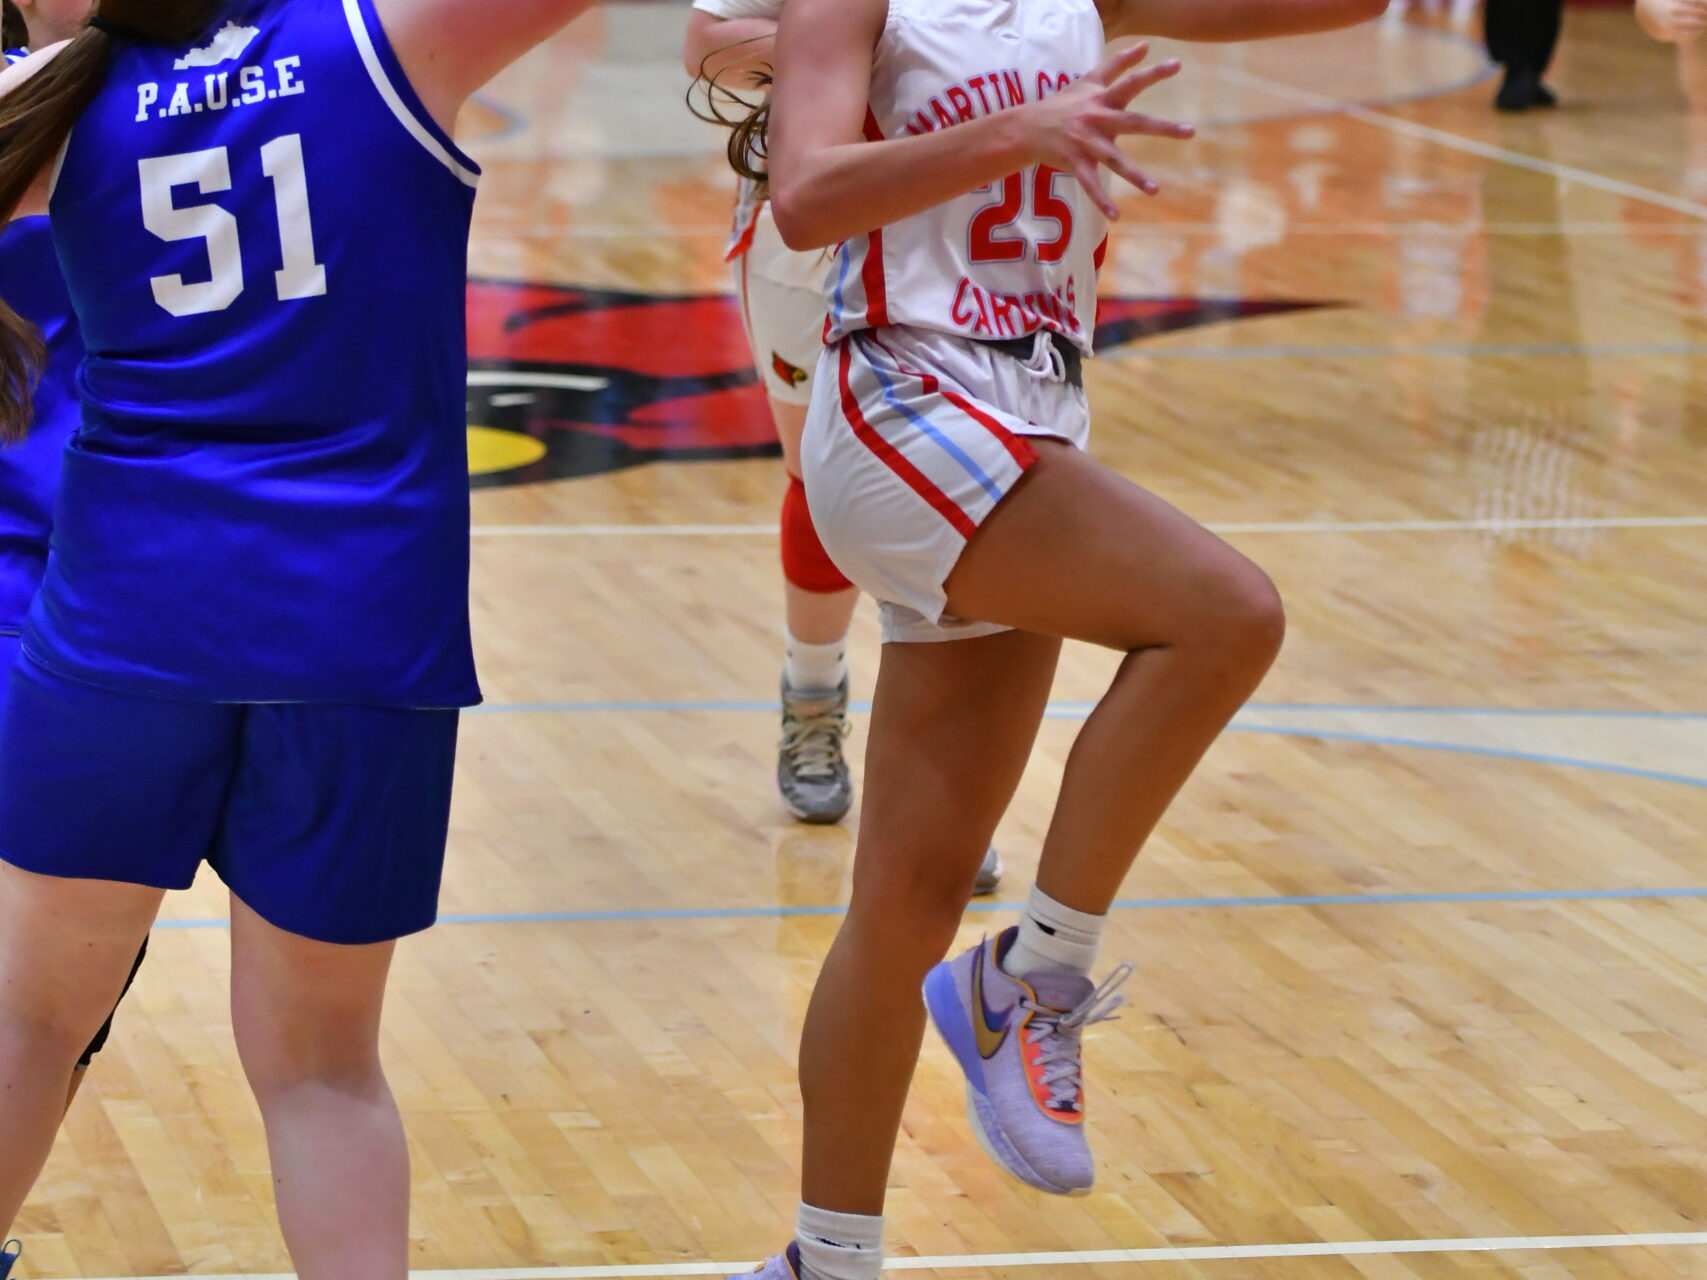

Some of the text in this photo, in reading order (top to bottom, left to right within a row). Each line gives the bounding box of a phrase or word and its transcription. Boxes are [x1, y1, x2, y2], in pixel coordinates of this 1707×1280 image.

[135, 55, 305, 122] P.A.U.S.E
[137, 133, 327, 317] 51
[966, 162, 1074, 265] 25
